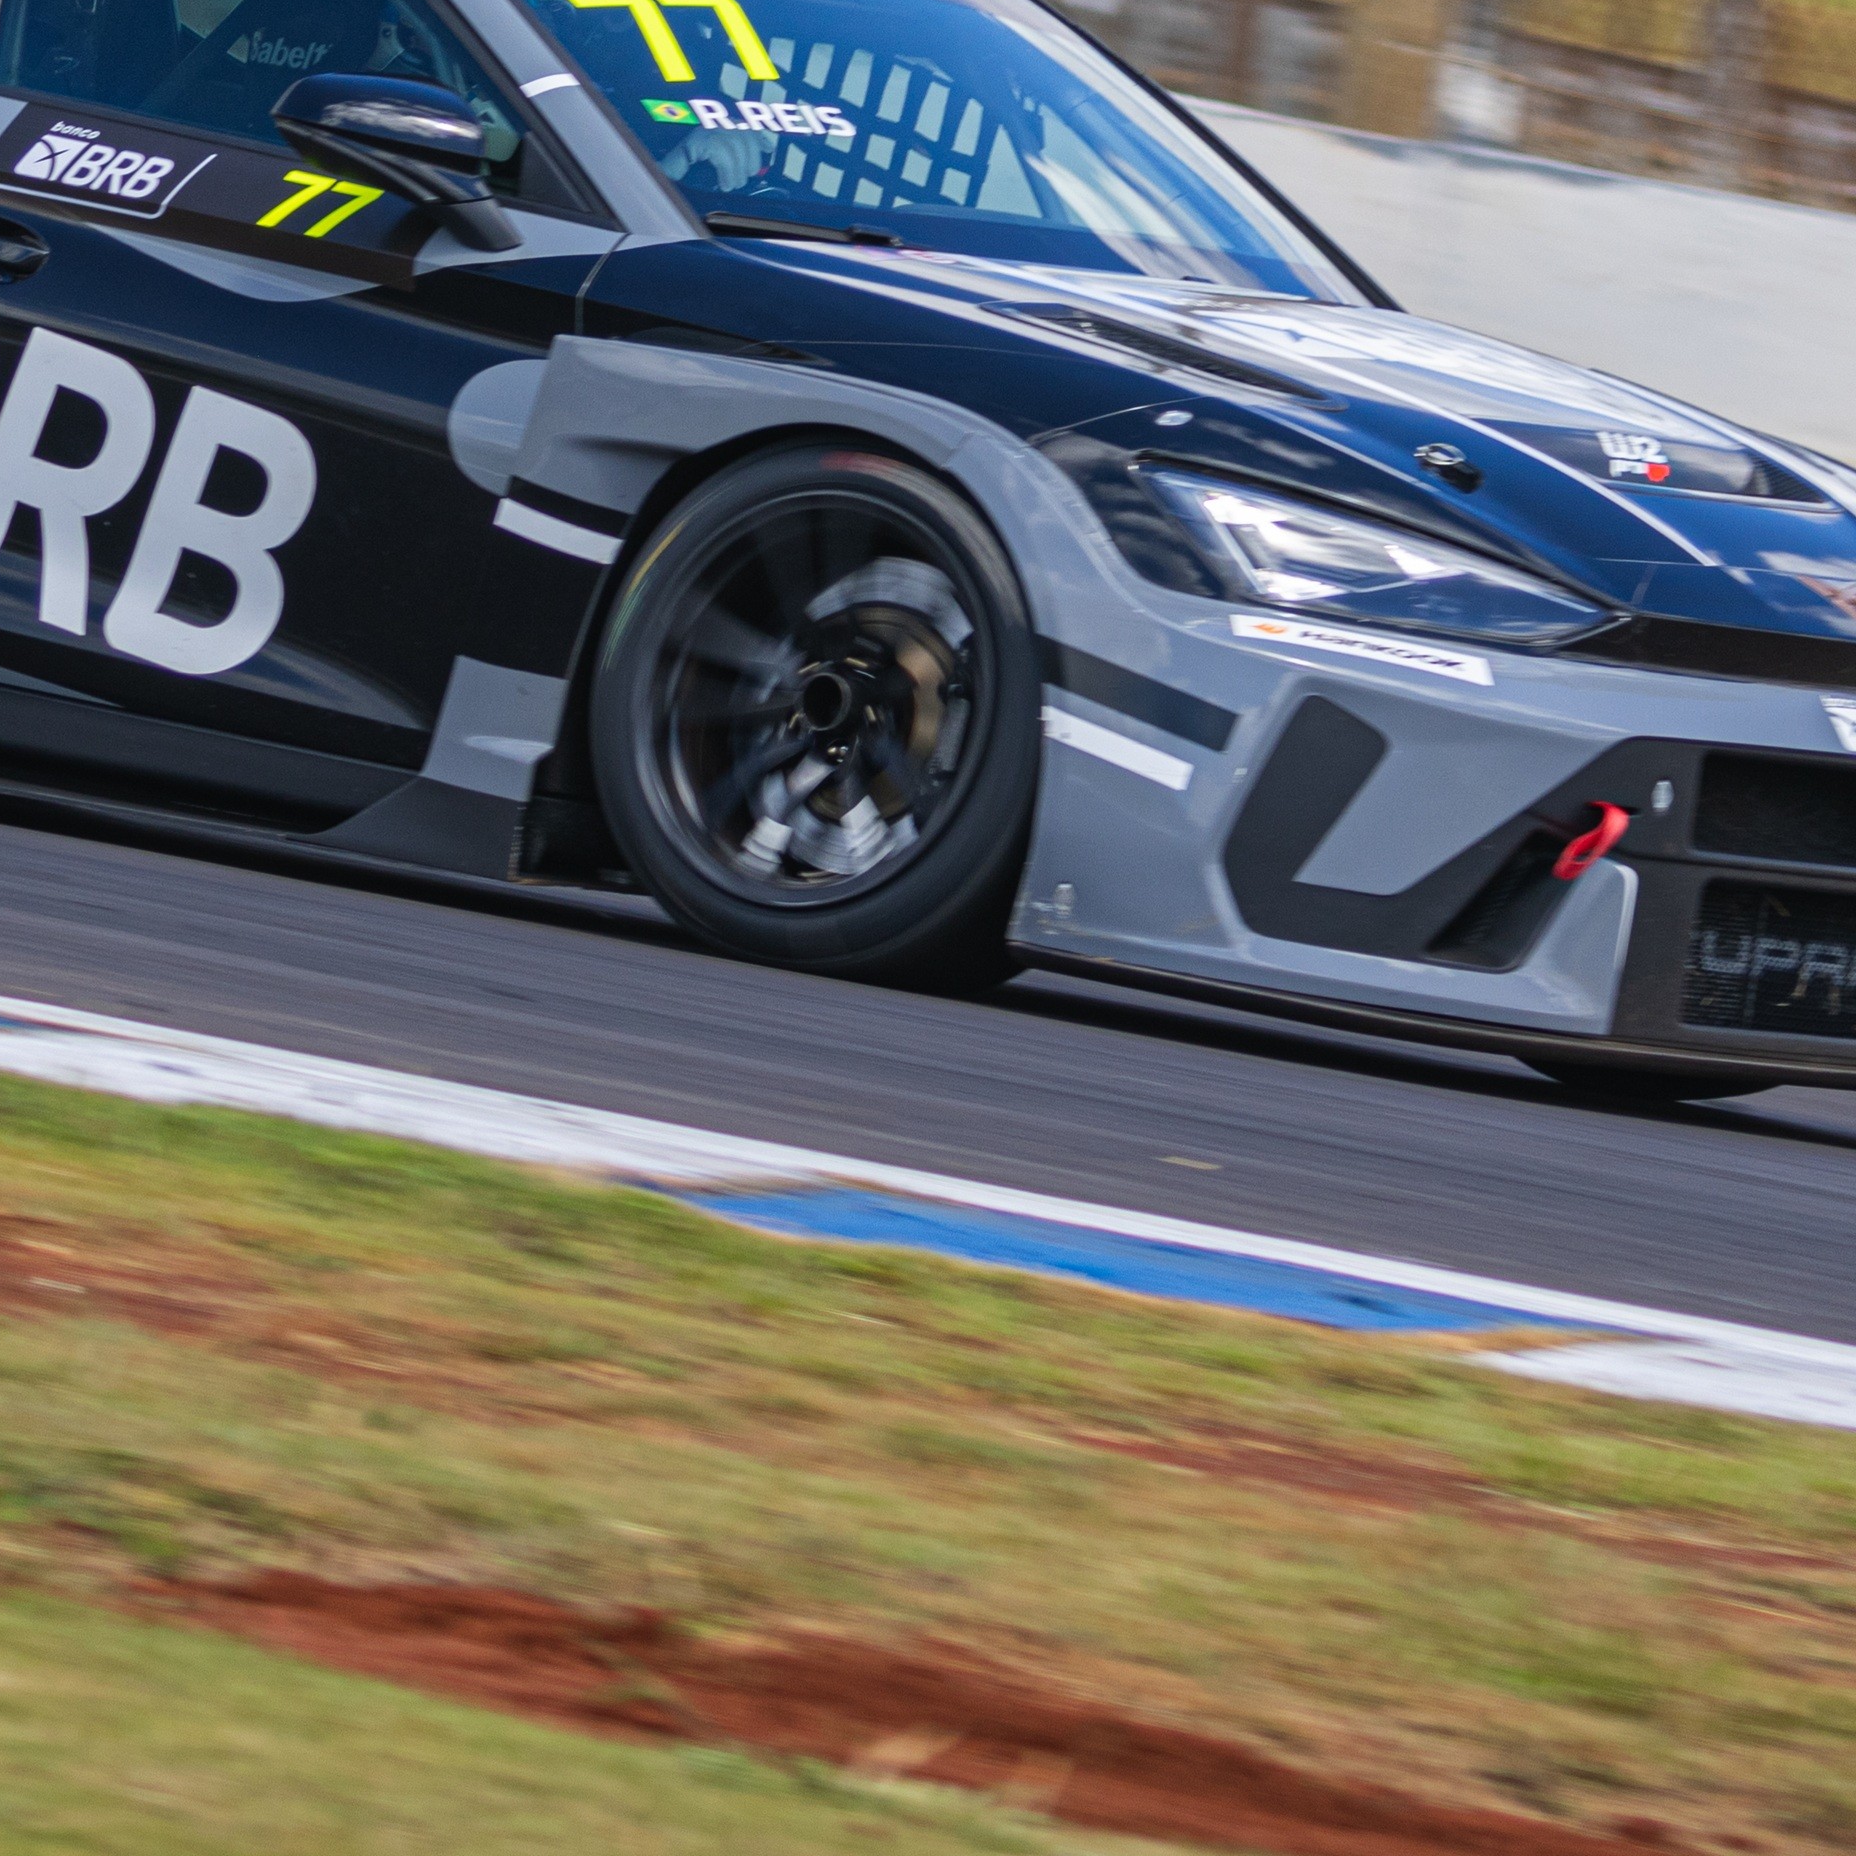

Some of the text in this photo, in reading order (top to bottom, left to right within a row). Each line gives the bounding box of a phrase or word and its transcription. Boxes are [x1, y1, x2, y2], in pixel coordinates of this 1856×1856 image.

[50, 120, 101, 140] banco
[61, 144, 175, 199] BRB
[256, 169, 385, 238] 77
